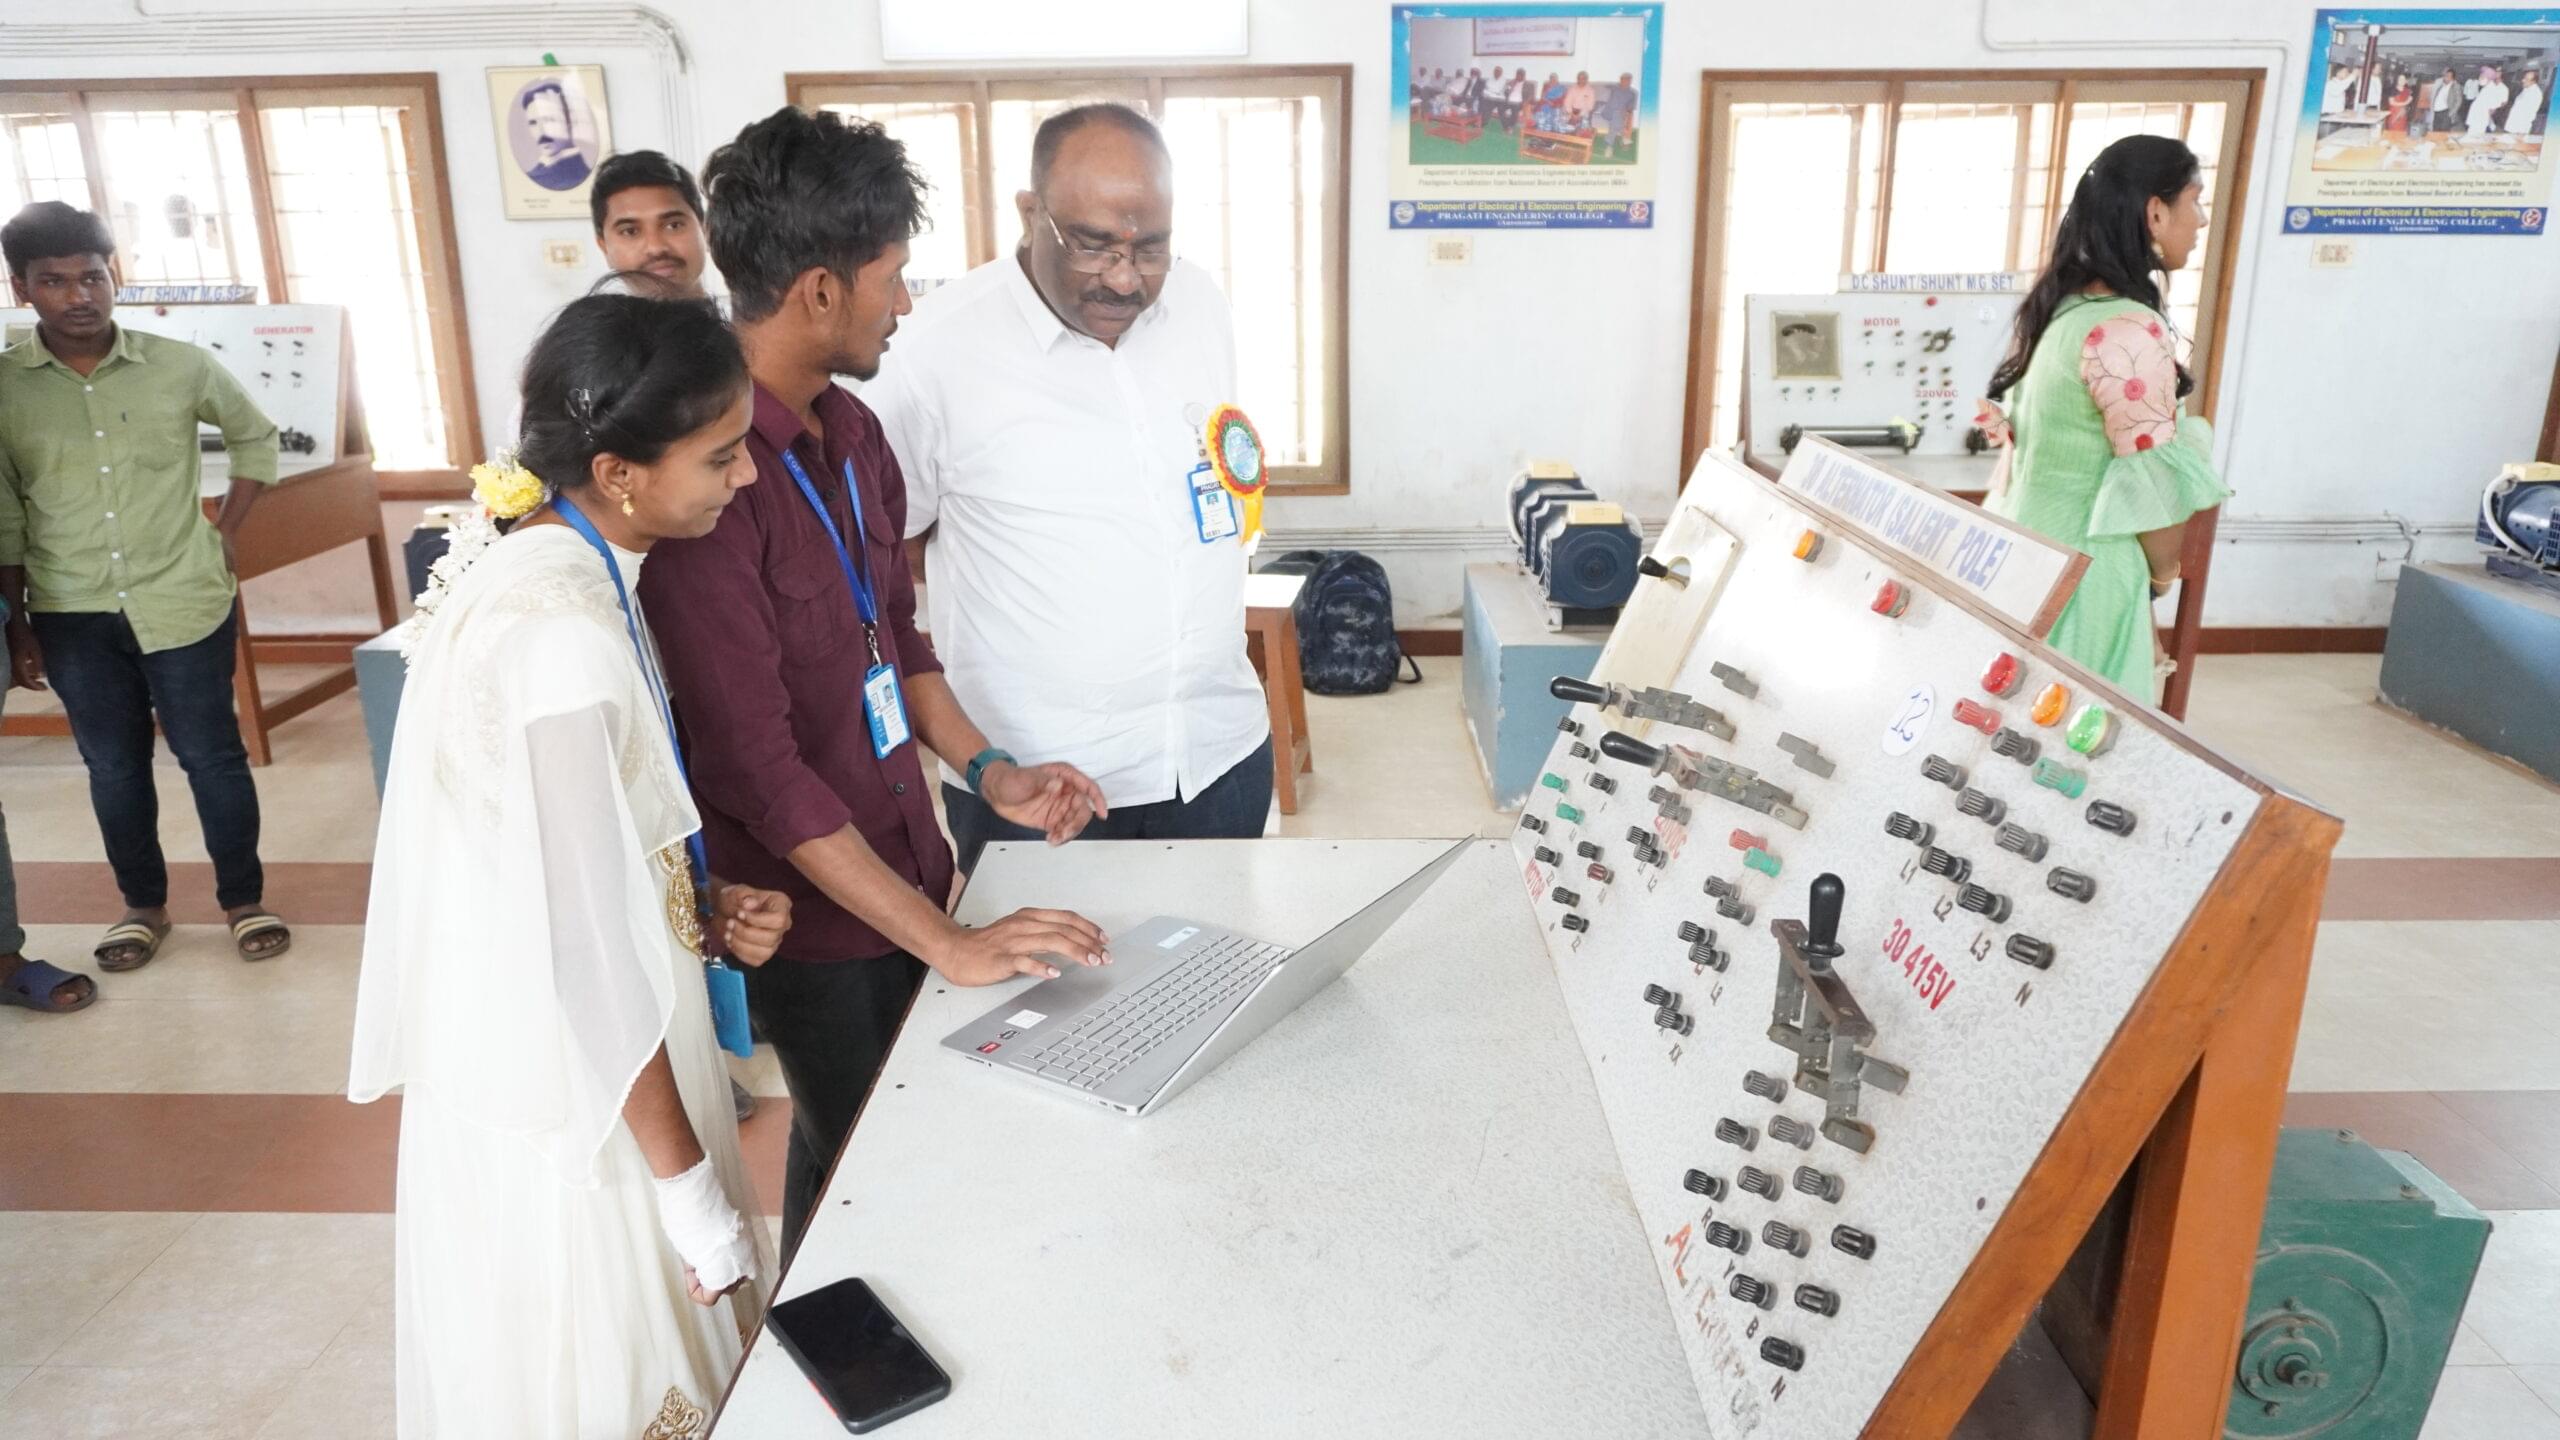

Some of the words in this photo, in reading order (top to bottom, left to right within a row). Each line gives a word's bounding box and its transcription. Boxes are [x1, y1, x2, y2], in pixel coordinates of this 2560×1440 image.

[1417, 202, 1466, 212] Department
[1468, 202, 1477, 212] of
[1478, 202, 1518, 212] Electrical
[1528, 202, 1575, 212] Electronics
[1576, 202, 1627, 212] Engineering
[2313, 208, 2361, 218] Department
[2363, 208, 2373, 218] of
[2373, 208, 2413, 218] Electrical
[2422, 208, 2469, 218] Electronics
[2471, 208, 2521, 218] Engineering
[2332, 218, 2376, 226] PRAGATI
[2379, 218, 2448, 226] ENGINEERING
[2450, 218, 2498, 226] COLLEGE
[155, 286, 197, 301] SHUNT
[1991, 275, 2015, 290] SET
[254, 326, 314, 335] GENERATOR
[1863, 318, 1901, 327] MOTOR
[1945, 525, 2014, 592] POLE)
[1890, 691, 1931, 742] 12
[1899, 858, 1918, 885] L1
[1933, 894, 1954, 923] L2
[1969, 931, 1992, 962] L3
[1904, 943, 1956, 1011] 415V
[2014, 980, 2033, 1008] N
[1701, 1206, 1713, 1229] R
[1723, 1258, 1736, 1280] Y
[1746, 1315, 1760, 1340] B
[1770, 1375, 1787, 1403] N
